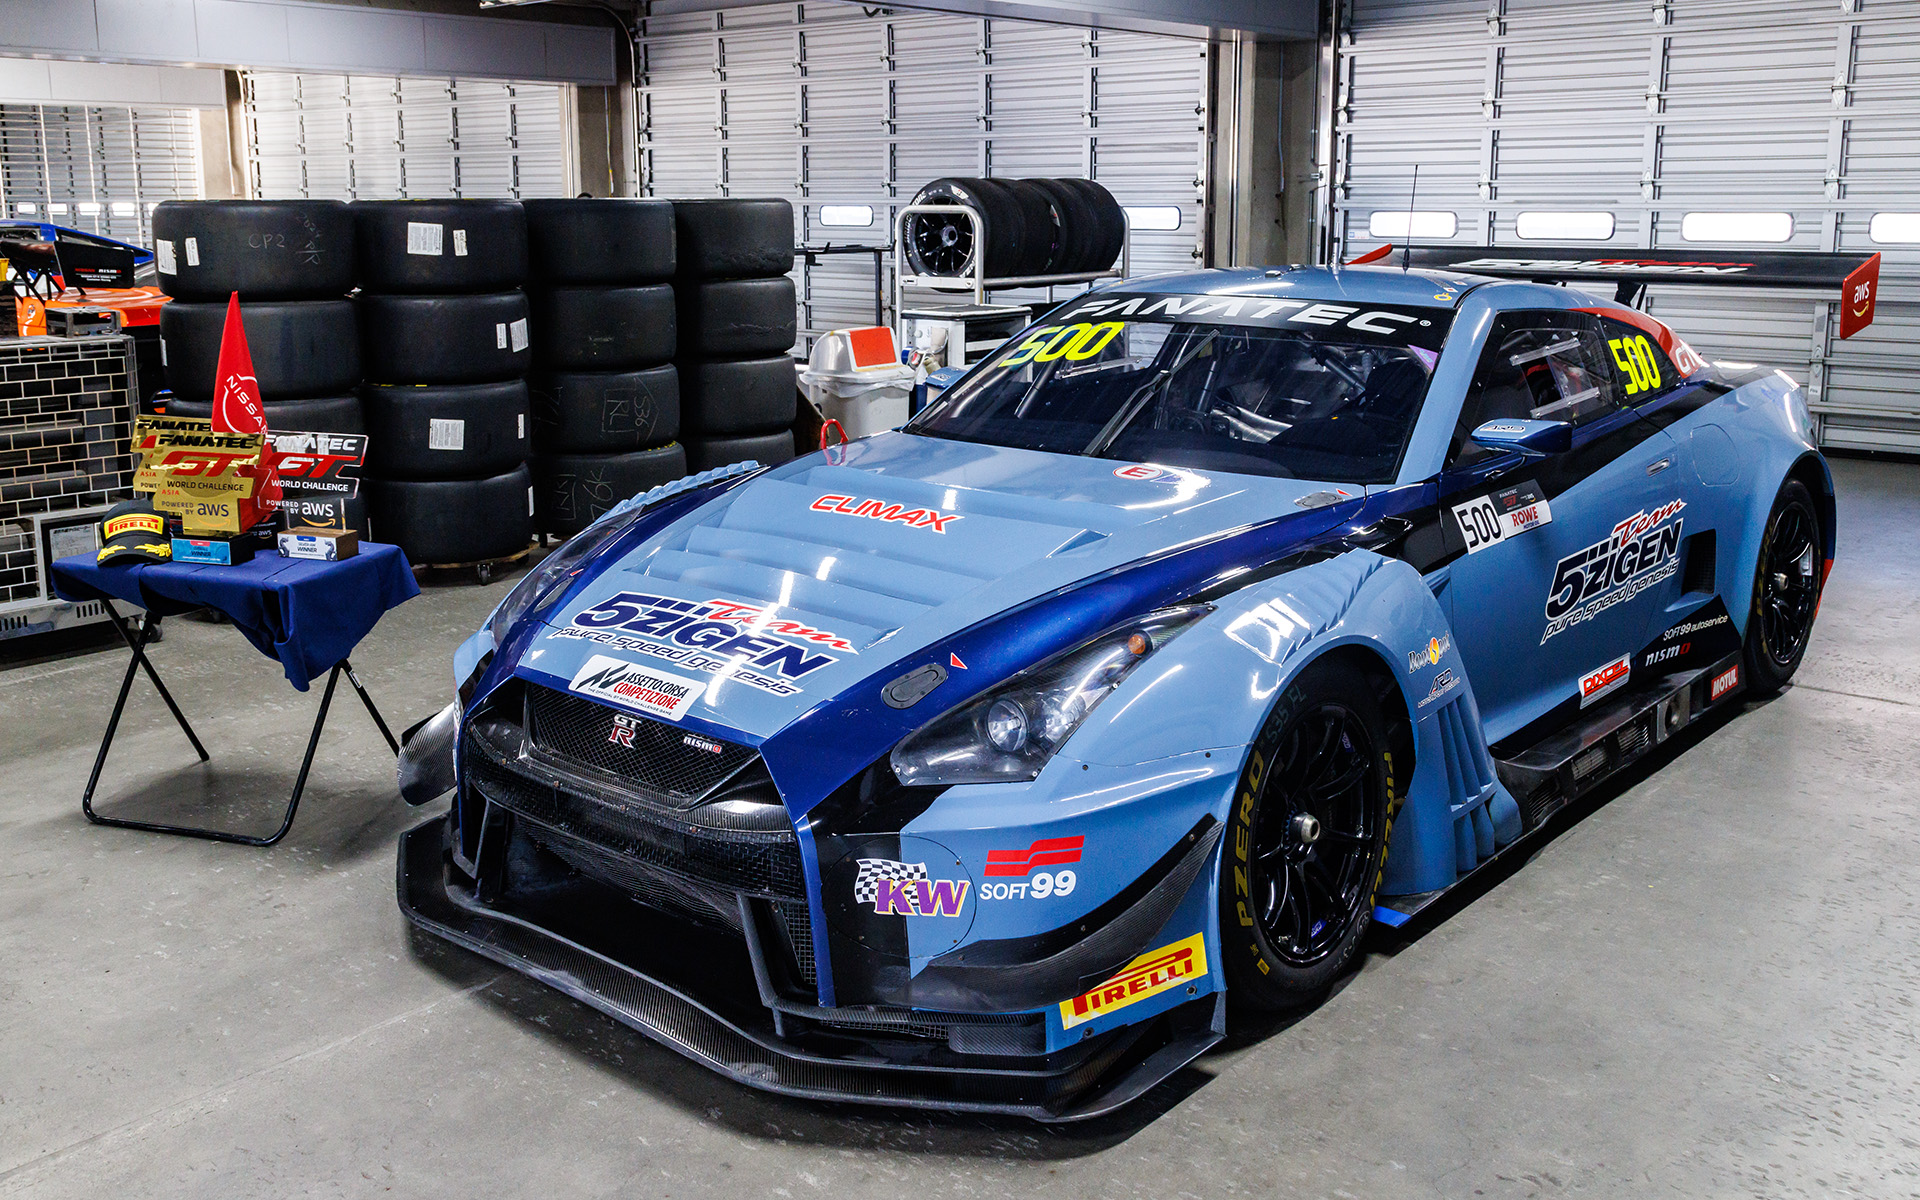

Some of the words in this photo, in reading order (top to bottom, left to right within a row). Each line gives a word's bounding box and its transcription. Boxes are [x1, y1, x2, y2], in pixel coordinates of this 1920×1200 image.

[1854, 281, 1870, 304] aws
[1060, 297, 1418, 335] FANATEC
[998, 322, 1125, 367] 500
[1608, 334, 1662, 395] 500
[137, 419, 211, 432] FANATE
[159, 434, 257, 449] FANATEC
[264, 434, 358, 451] FANATEC
[161, 451, 257, 477] GT
[265, 452, 358, 478] GT
[1121, 467, 1156, 478] E
[167, 480, 196, 489] WORLD
[198, 482, 244, 491] CHALLENGE
[271, 480, 300, 489] WORLD
[302, 481, 349, 492] CHALLENGE
[197, 502, 229, 517] aws
[266, 499, 299, 508] POWERED
[302, 502, 334, 517] aws
[811, 494, 963, 534] CLIMAX
[109, 516, 159, 534] PIRELLI
[1457, 502, 1502, 549] 500
[1511, 506, 1539, 527] ROWE
[1612, 500, 1684, 547] Team
[1542, 607, 1583, 643] pure
[1584, 584, 1627, 620] speed
[1626, 560, 1679, 602] genesis
[1691, 614, 1728, 631] autoservice
[612, 638, 693, 661] speed
[682, 657, 797, 694] geesis
[1645, 642, 1691, 667] nismo
[1584, 660, 1629, 694] DIXCEL
[1712, 671, 1737, 697] MOTUL
[613, 682, 681, 710] COMPETIZIONE
[634, 700, 659, 711] CHALLENGE
[659, 708, 672, 716] GAME
[614, 713, 641, 729] GT
[608, 724, 634, 748] R
[683, 736, 722, 753] nismo
[875, 879, 969, 917] KW
[1072, 947, 1193, 1016] PIRELLI
